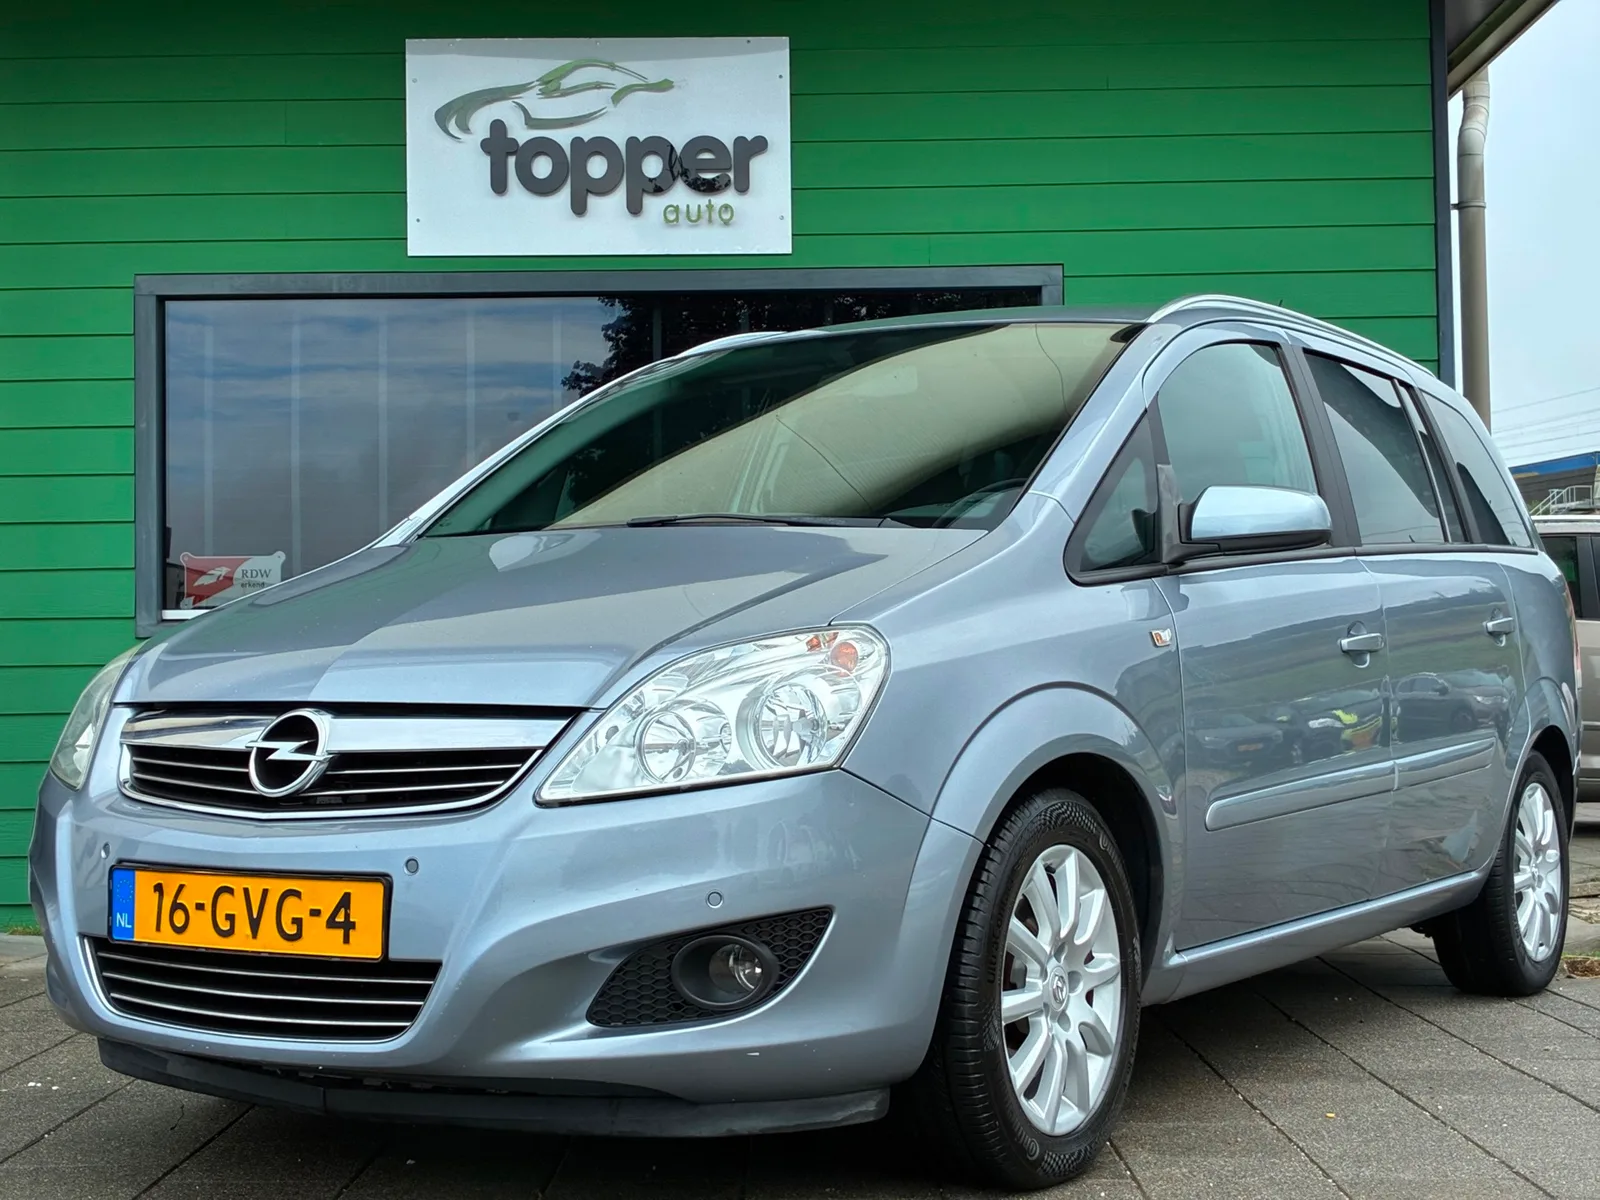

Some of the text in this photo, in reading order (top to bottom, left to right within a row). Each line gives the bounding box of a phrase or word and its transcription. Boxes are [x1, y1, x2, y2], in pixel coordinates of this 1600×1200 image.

[480, 118, 769, 216] topper
[663, 199, 735, 226] auto
[241, 568, 272, 579] RDW
[240, 581, 265, 589] erkend
[116, 912, 132, 929] NL
[153, 882, 356, 944] 16-GVG-4
